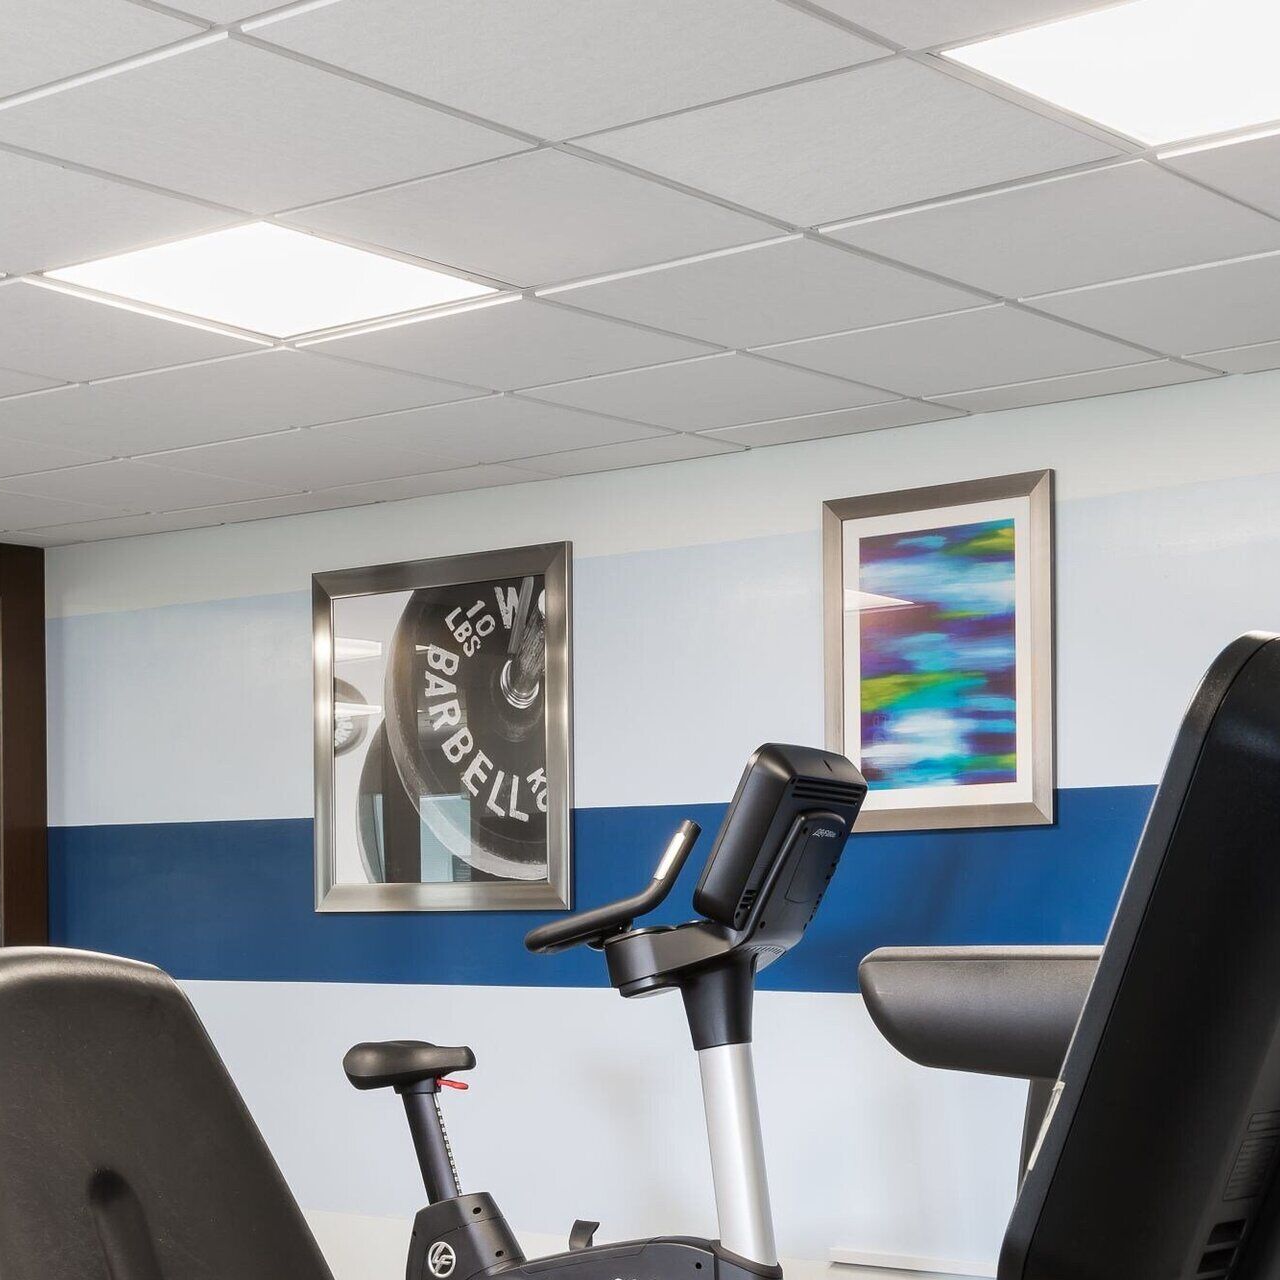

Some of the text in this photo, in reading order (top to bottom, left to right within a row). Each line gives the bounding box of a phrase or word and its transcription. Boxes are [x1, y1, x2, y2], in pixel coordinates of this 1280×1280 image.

[444, 606, 481, 658] LBS
[465, 599, 496, 637] 10
[424, 643, 530, 823] BARBELL
